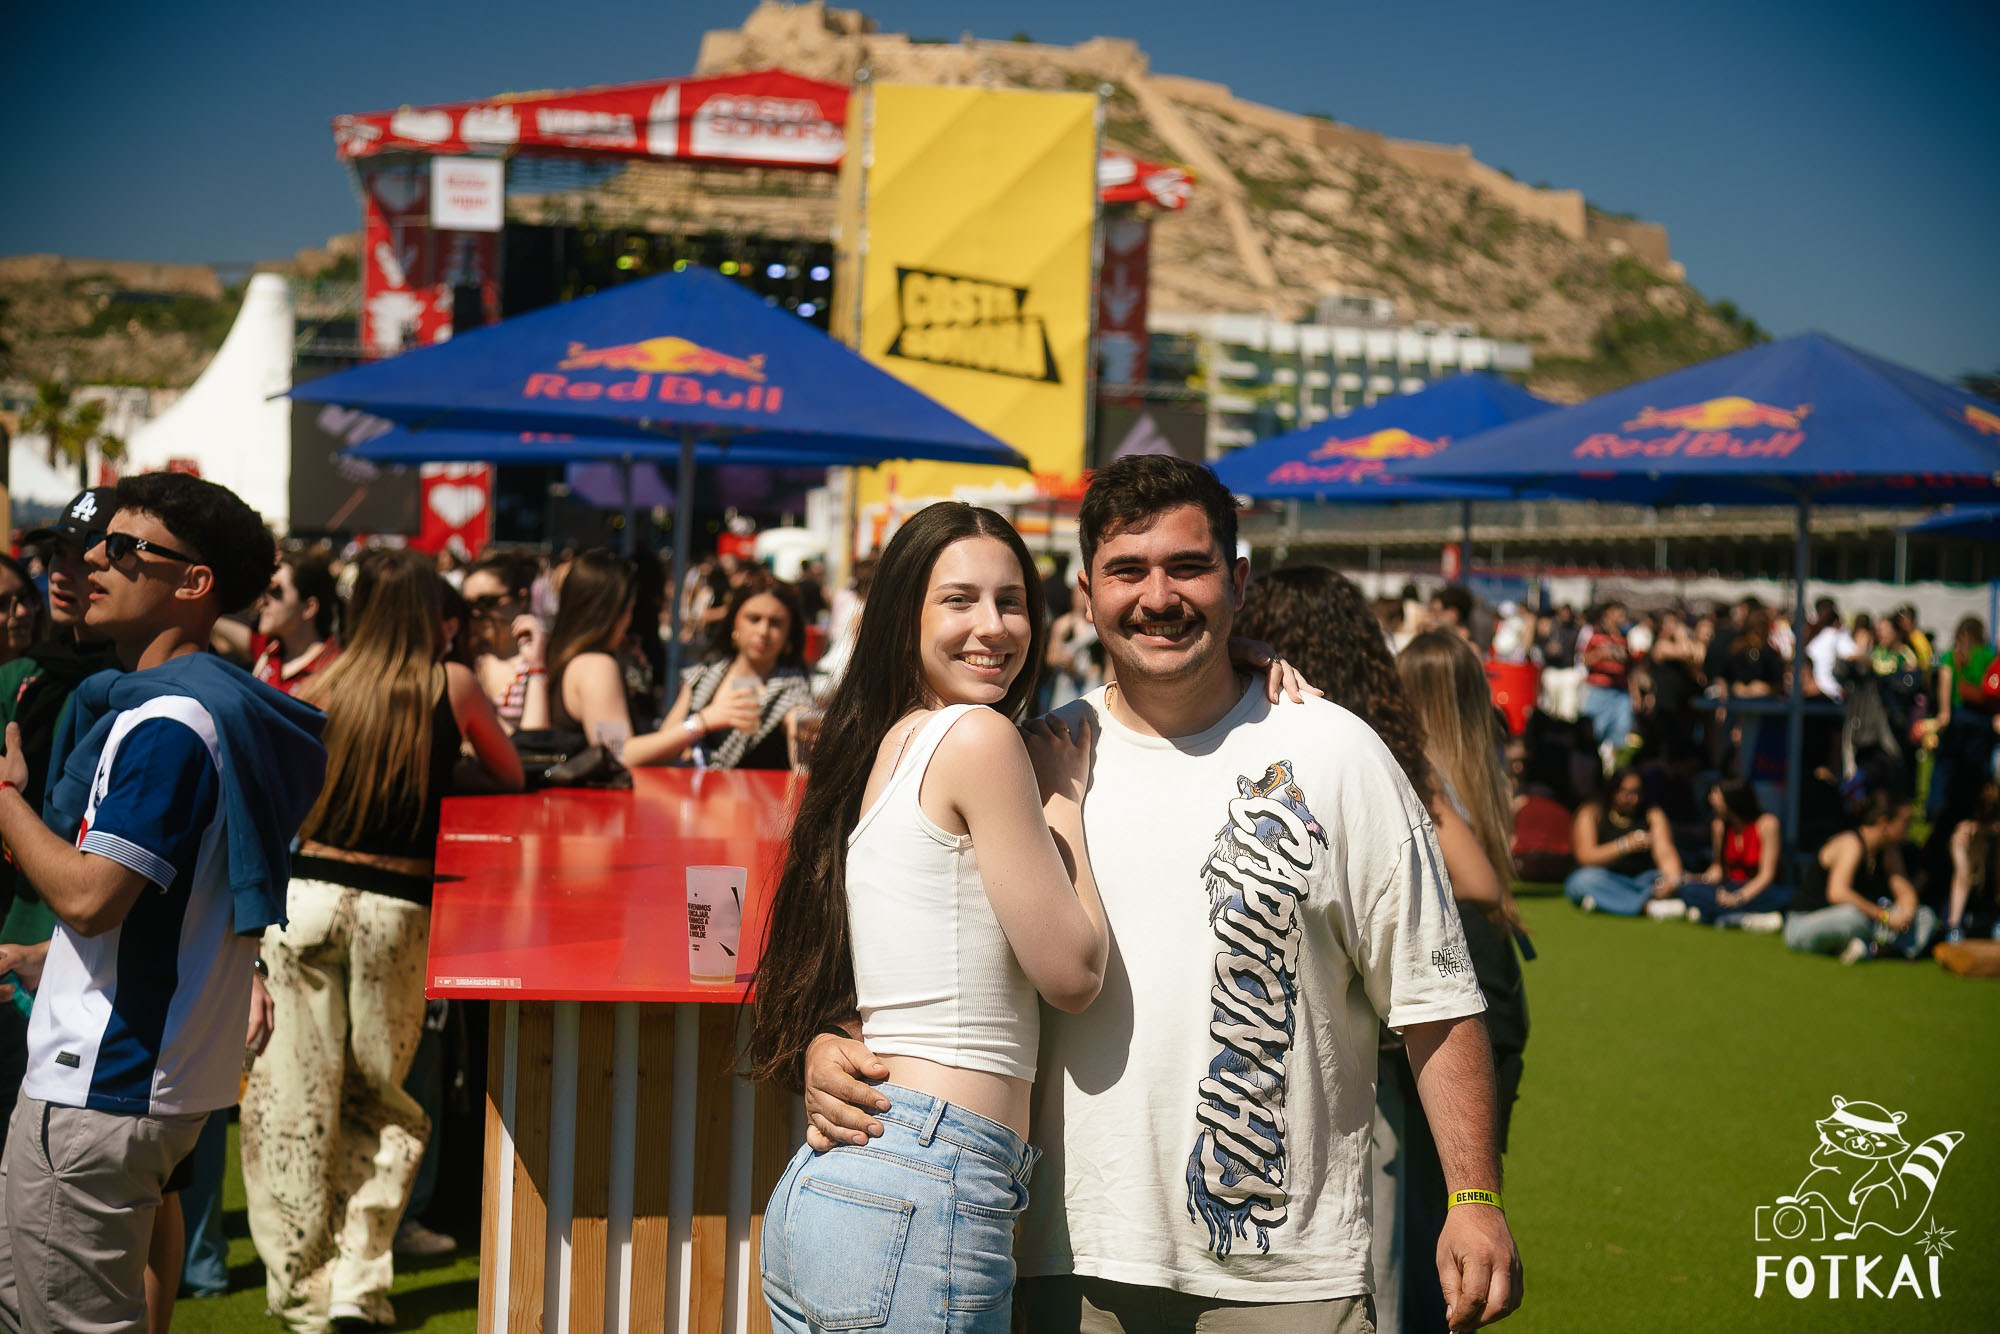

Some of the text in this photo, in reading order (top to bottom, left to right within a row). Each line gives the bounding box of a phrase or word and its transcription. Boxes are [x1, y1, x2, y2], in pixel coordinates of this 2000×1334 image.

[523, 373, 784, 414] Red Bull
[1573, 429, 1806, 458] Red Bull
[1456, 1191, 1494, 1203] GENERAL
